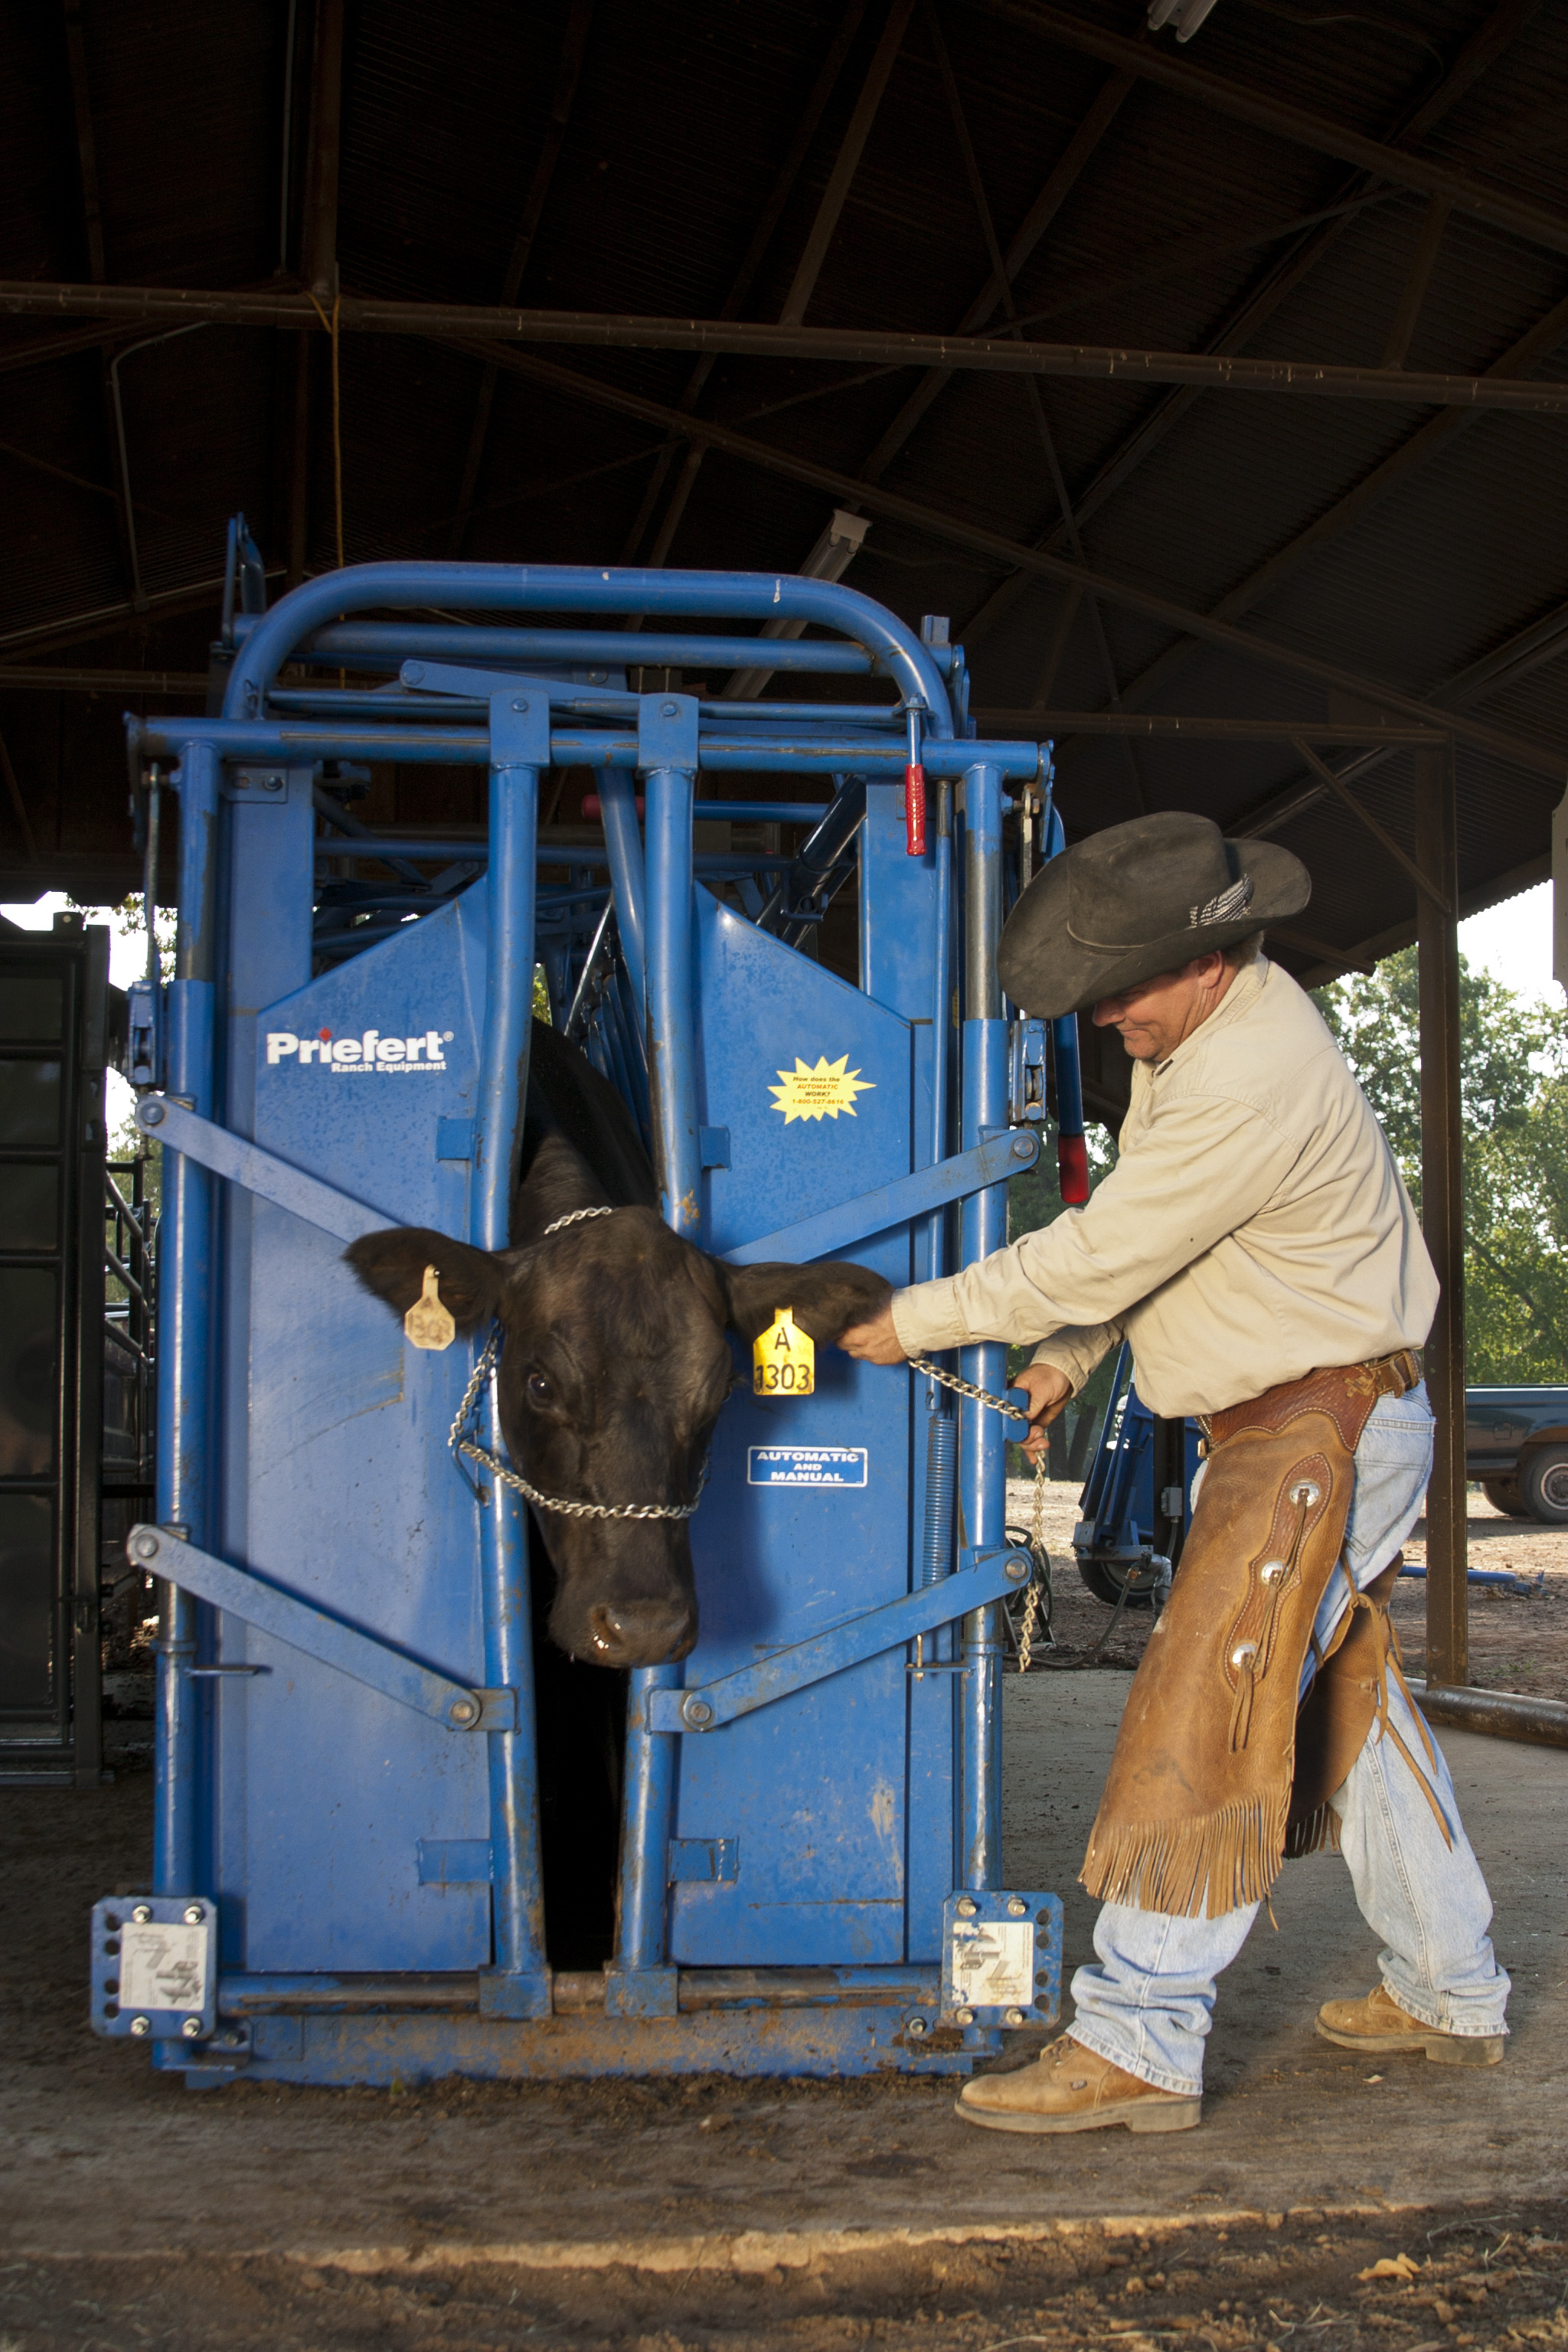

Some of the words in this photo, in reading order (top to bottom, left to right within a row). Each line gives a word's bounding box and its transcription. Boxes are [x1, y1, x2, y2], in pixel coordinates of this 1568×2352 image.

[266, 1028, 444, 1064] Priefert
[331, 1062, 373, 1073] Ranch
[376, 1061, 446, 1073] Equipment
[774, 1327, 791, 1352] A
[756, 1364, 811, 1390] 1303
[756, 1451, 859, 1462] AUTOMATIC
[770, 1472, 844, 1482] MANUAL
